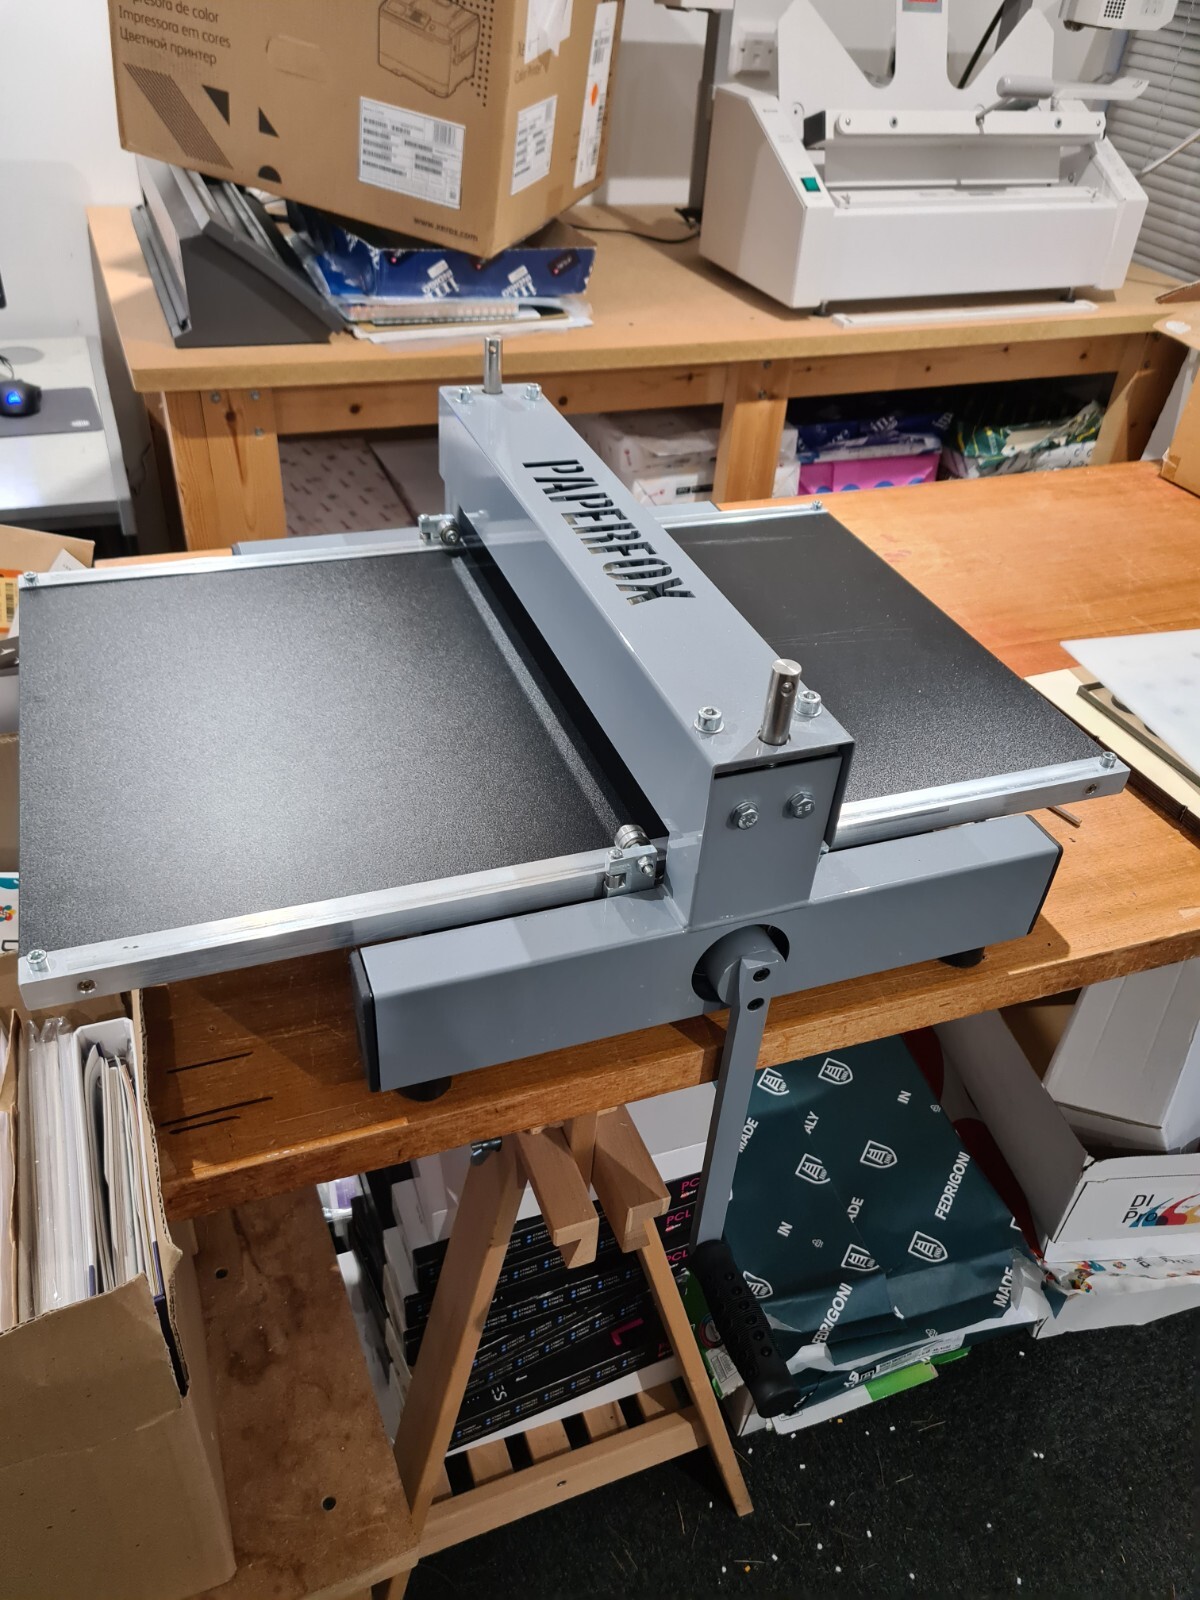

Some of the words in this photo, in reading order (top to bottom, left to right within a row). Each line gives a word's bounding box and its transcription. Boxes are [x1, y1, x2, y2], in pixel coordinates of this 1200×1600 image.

[175, 1, 190, 15] de
[192, 7, 219, 23] color
[118, 5, 179, 34] Impressora
[181, 25, 200, 39] em
[202, 31, 231, 48] cores
[119, 26, 168, 51] Цветной
[169, 42, 217, 66] принтер
[413, 217, 479, 242] www.xerox.com
[522, 459, 696, 606] PAPERFOX
[897, 1090, 912, 1105] IN
[681, 1177, 701, 1190] PC
[934, 1151, 971, 1221] FEDRIGONI
[1130, 1194, 1155, 1208] DI
[666, 1209, 692, 1225] PCL
[1121, 1210, 1158, 1224] Pro
[777, 1221, 793, 1237] IN
[812, 1282, 853, 1344] FEDRIGONI
